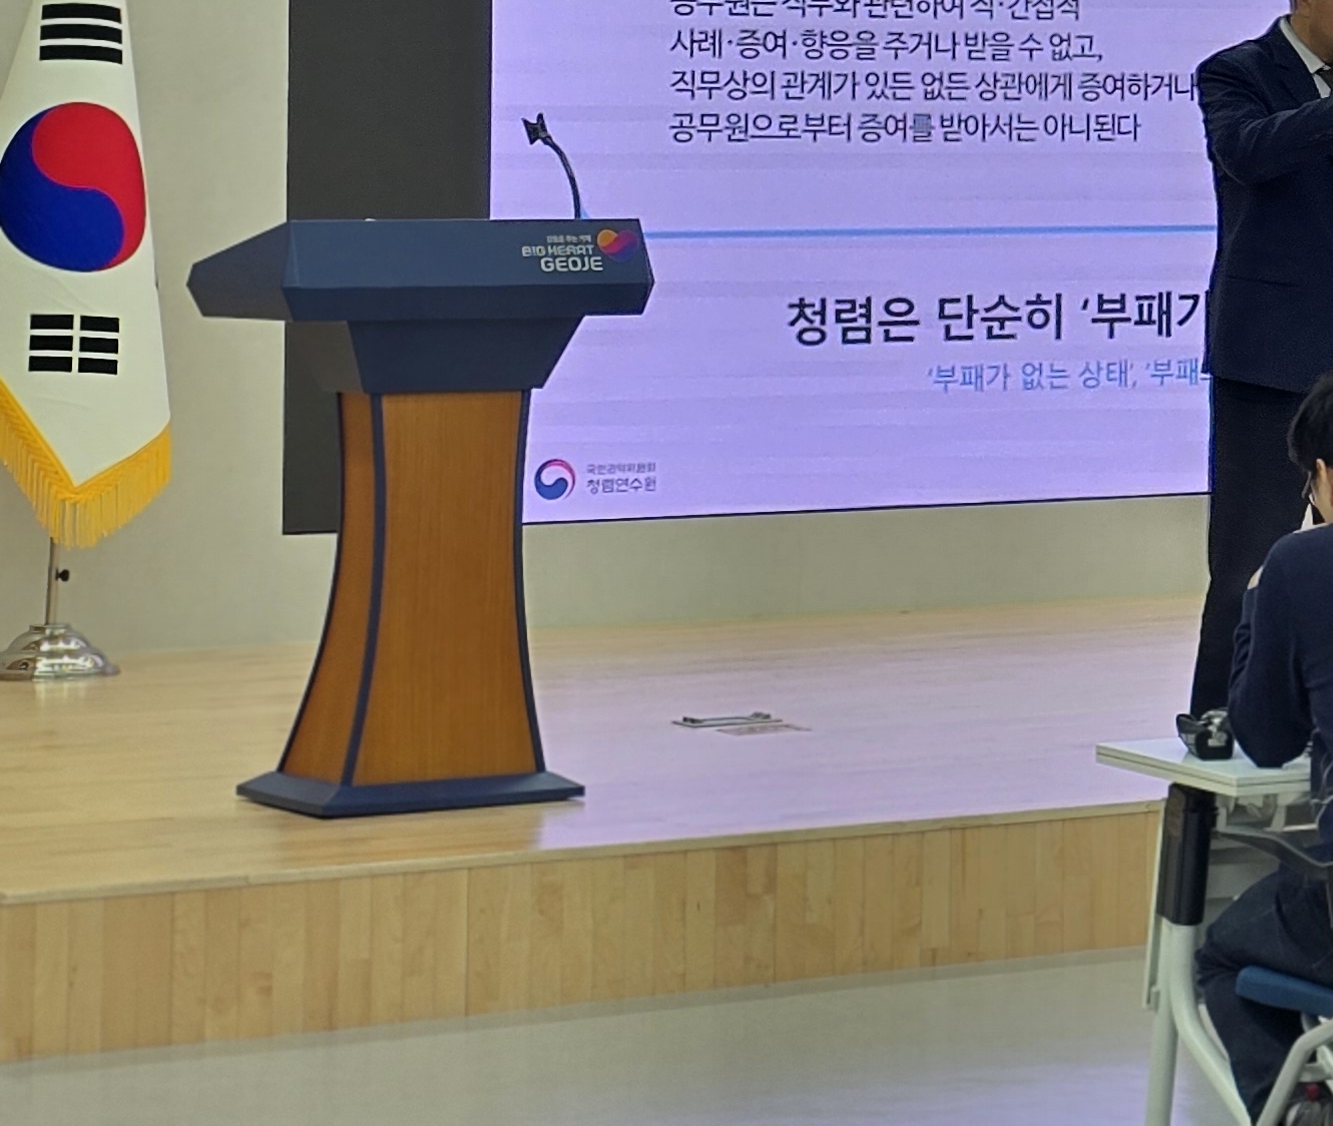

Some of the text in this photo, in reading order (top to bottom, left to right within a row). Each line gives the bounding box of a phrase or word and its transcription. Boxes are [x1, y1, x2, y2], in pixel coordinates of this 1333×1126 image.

[883, 30, 960, 62] 주거나
[965, 31, 1015, 62] 받을
[1018, 33, 1044, 62] 수
[1049, 32, 1103, 63] 없고,
[670, 70, 1197, 103] 직무상의 관계가 있든 없든 상관에게 증여하거나
[669, 112, 1142, 144] 공무원으로부터 증여를 받아서는 아니된다
[540, 256, 603, 272] GEOJE
[786, 294, 920, 347] 청렴은
[938, 292, 1063, 342] 단순히
[927, 364, 1010, 394] ‘부패가
[1021, 362, 1070, 391] 없는
[1145, 357, 1211, 387] ‘부패
